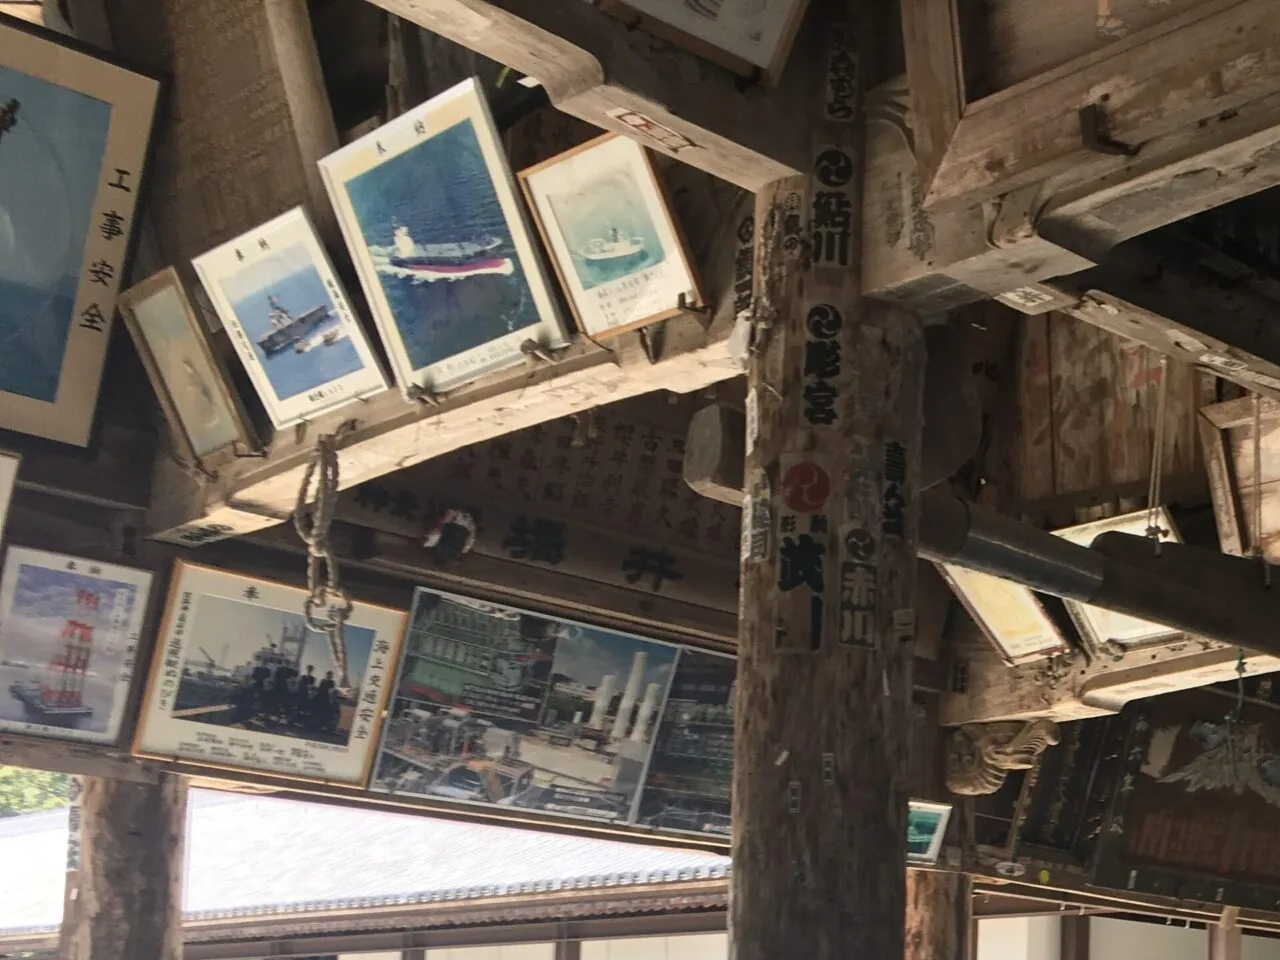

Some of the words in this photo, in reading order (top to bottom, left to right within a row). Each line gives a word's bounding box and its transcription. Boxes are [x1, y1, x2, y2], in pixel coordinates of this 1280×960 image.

[79, 167, 132, 333] 工事安全
[842, 564, 877, 645] 赤川
[353, 638, 391, 740] 海上交通安全
